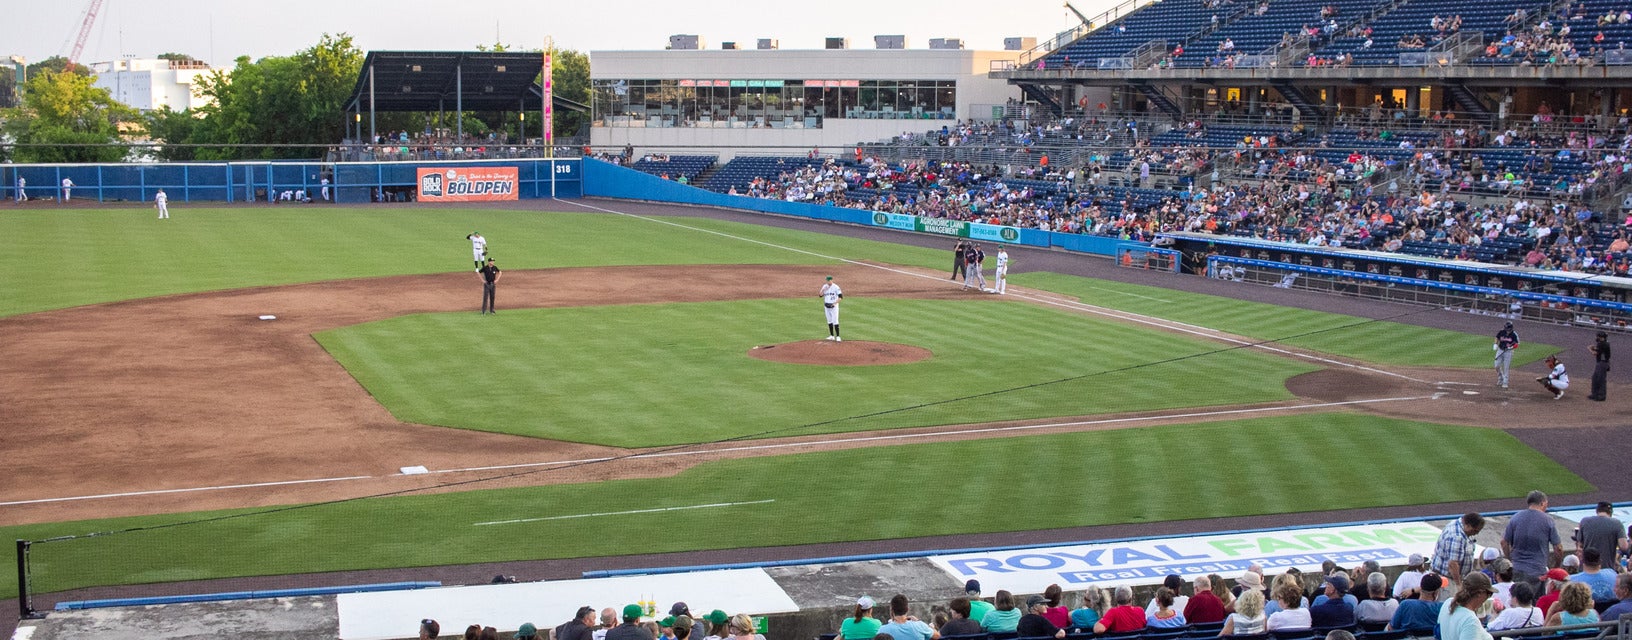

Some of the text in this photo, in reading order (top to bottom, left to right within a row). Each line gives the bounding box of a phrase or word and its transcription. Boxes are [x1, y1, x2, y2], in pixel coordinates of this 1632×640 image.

[556, 165, 571, 173] 318
[423, 177, 441, 185] BOLD
[423, 184, 441, 192] ROCK
[447, 180, 512, 195] BOLDPEN
[920, 217, 964, 229] AGRONOMIC LAWN
[924, 225, 959, 235] MANAGEMENT
[948, 526, 1440, 576] ROYAL FARMS
[1074, 550, 1396, 582] Real Fresh. Real Fast.
